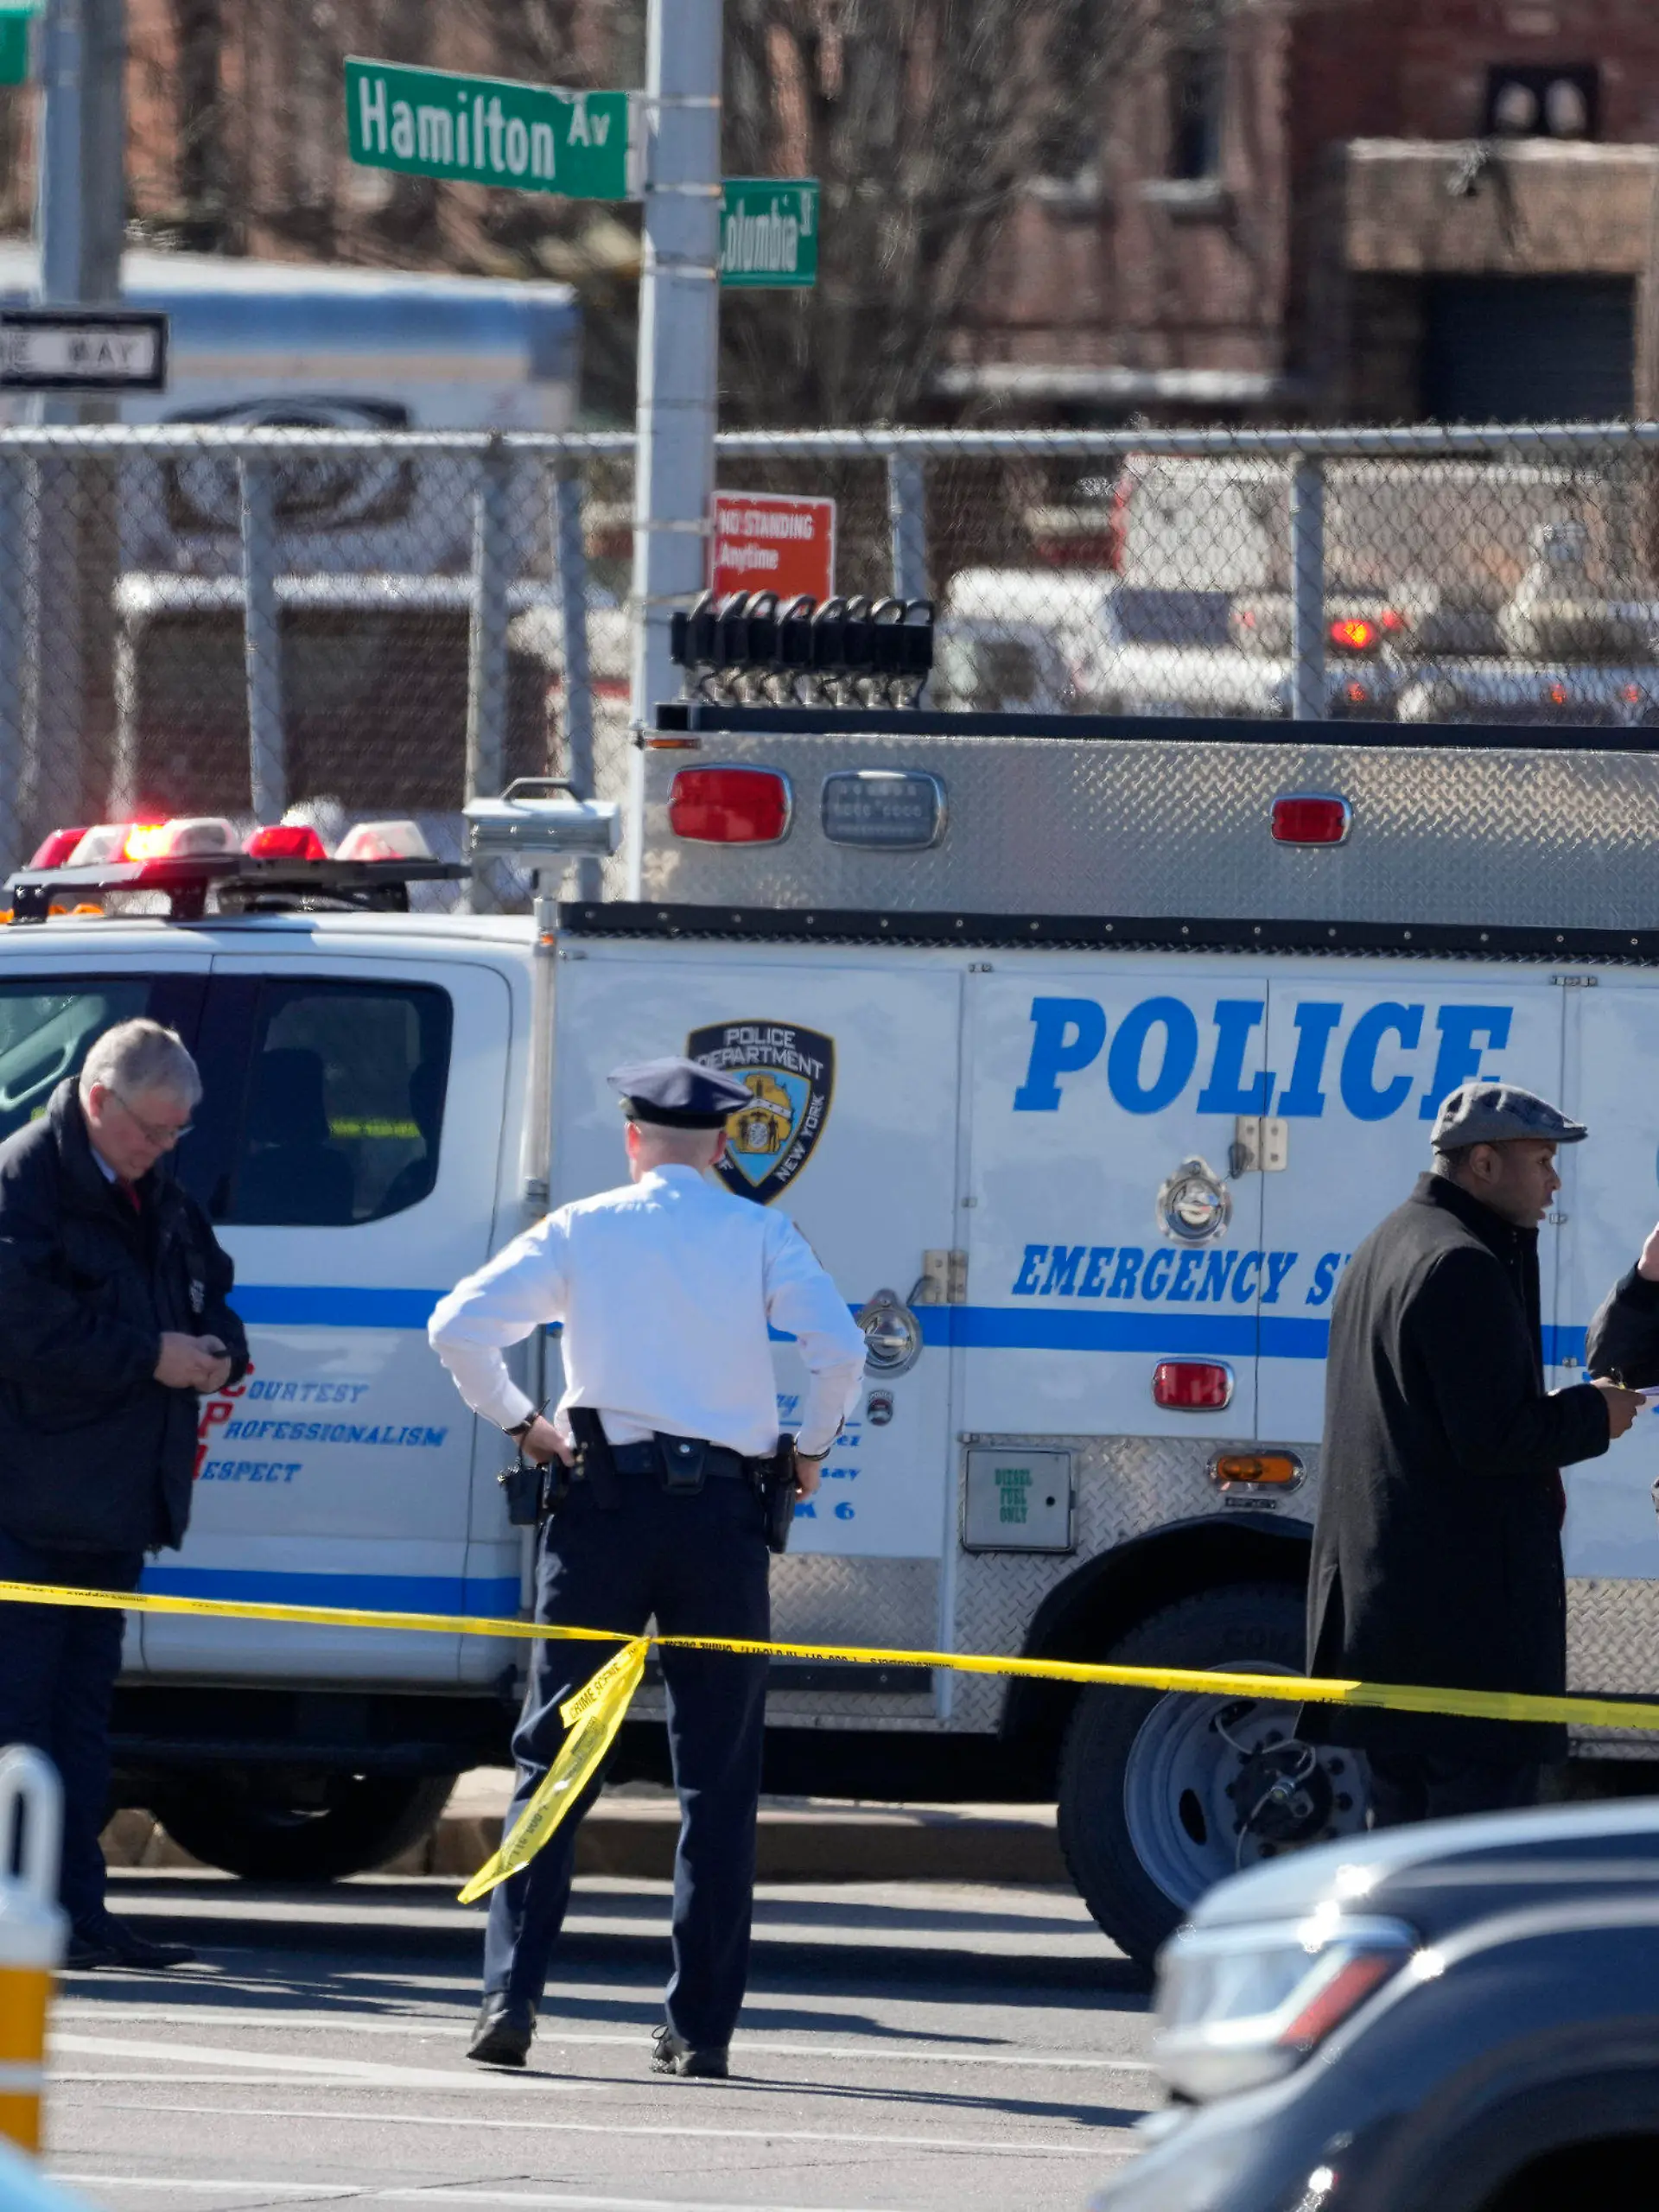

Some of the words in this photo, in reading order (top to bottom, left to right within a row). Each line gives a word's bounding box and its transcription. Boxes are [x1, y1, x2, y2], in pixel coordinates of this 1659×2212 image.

[359, 77, 556, 180] Hamilton
[567, 104, 610, 147] Av
[721, 195, 797, 272] olumbia
[721, 508, 741, 534] NO
[744, 510, 814, 539] STANDING
[719, 542, 778, 574] Anytime
[724, 1027, 796, 1049] POLICE
[696, 1046, 824, 1080] DEPARTMENT
[1013, 997, 1514, 1121] POLICE
[774, 1141, 806, 1182] NEW
[800, 1092, 825, 1139] YORK
[1012, 1245, 1298, 1304] EMERGENCY
[197, 1401, 448, 1448] PROFESSIONALISM
[835, 1502, 855, 1521] 6
[569, 1688, 597, 1719] CRIME
